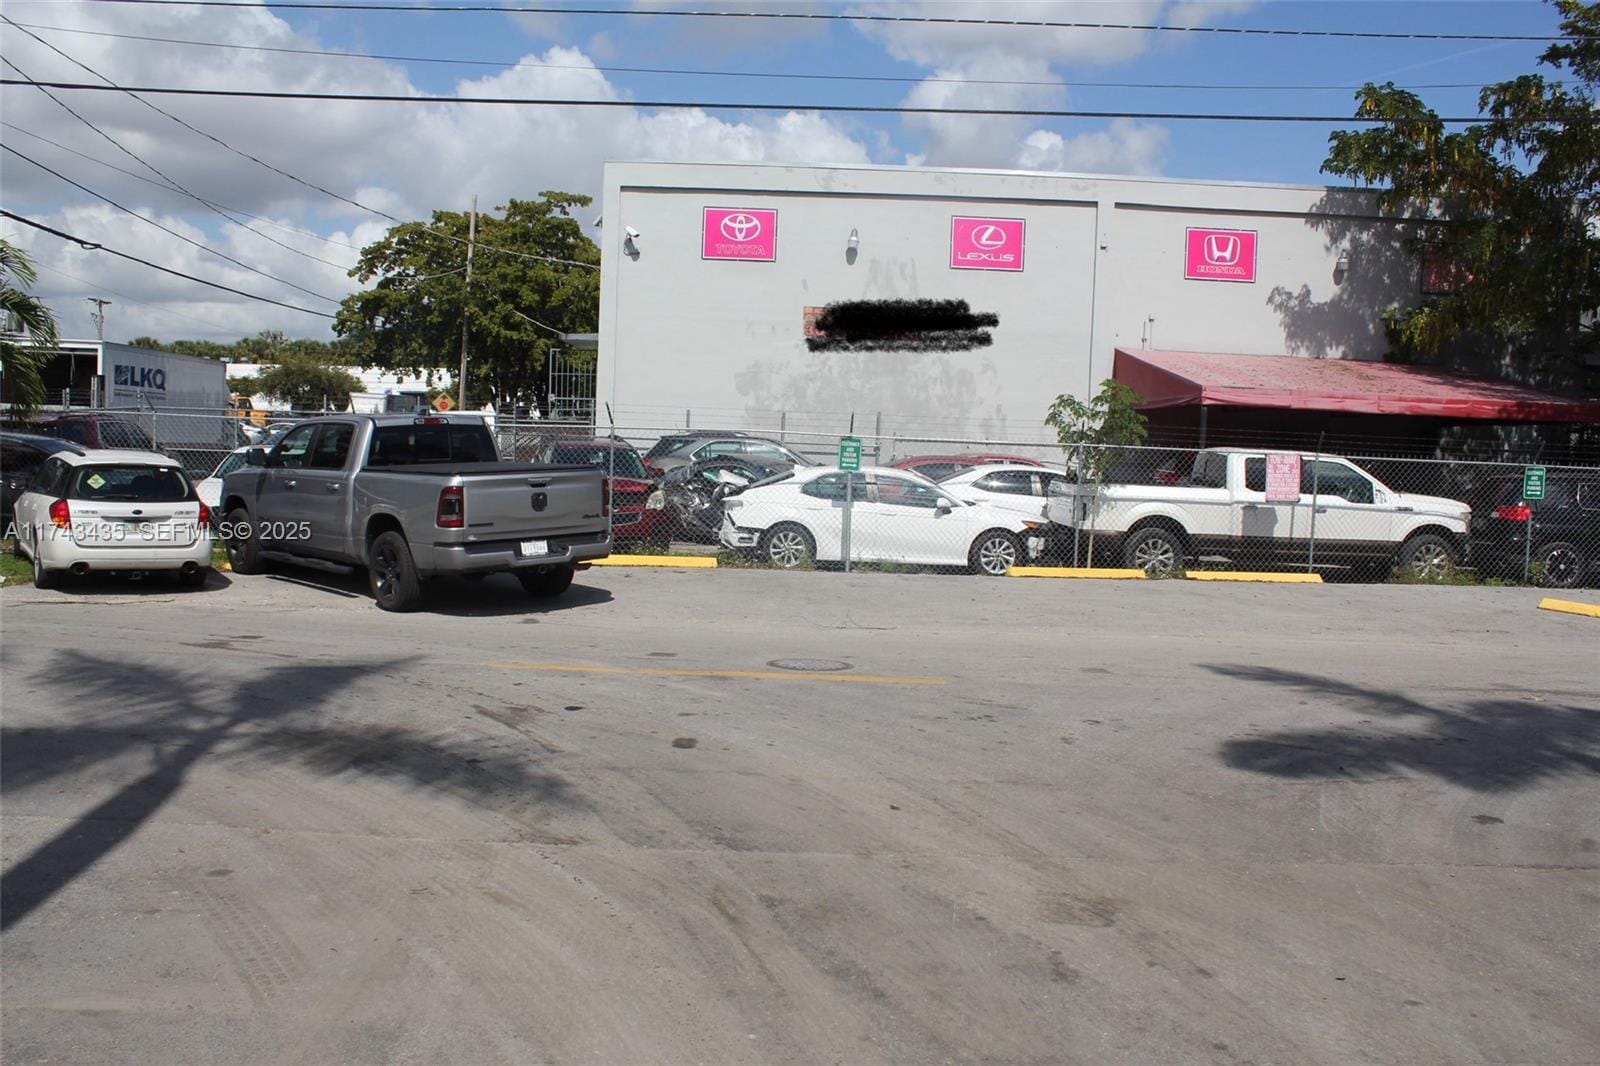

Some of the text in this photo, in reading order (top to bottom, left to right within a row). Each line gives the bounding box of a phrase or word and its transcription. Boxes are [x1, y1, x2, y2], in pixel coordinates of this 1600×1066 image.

[715, 243, 767, 256] TOYOTA
[957, 251, 1015, 263] LEXUS
[1196, 264, 1246, 275] HONDA
[130, 366, 166, 391] LKQ
